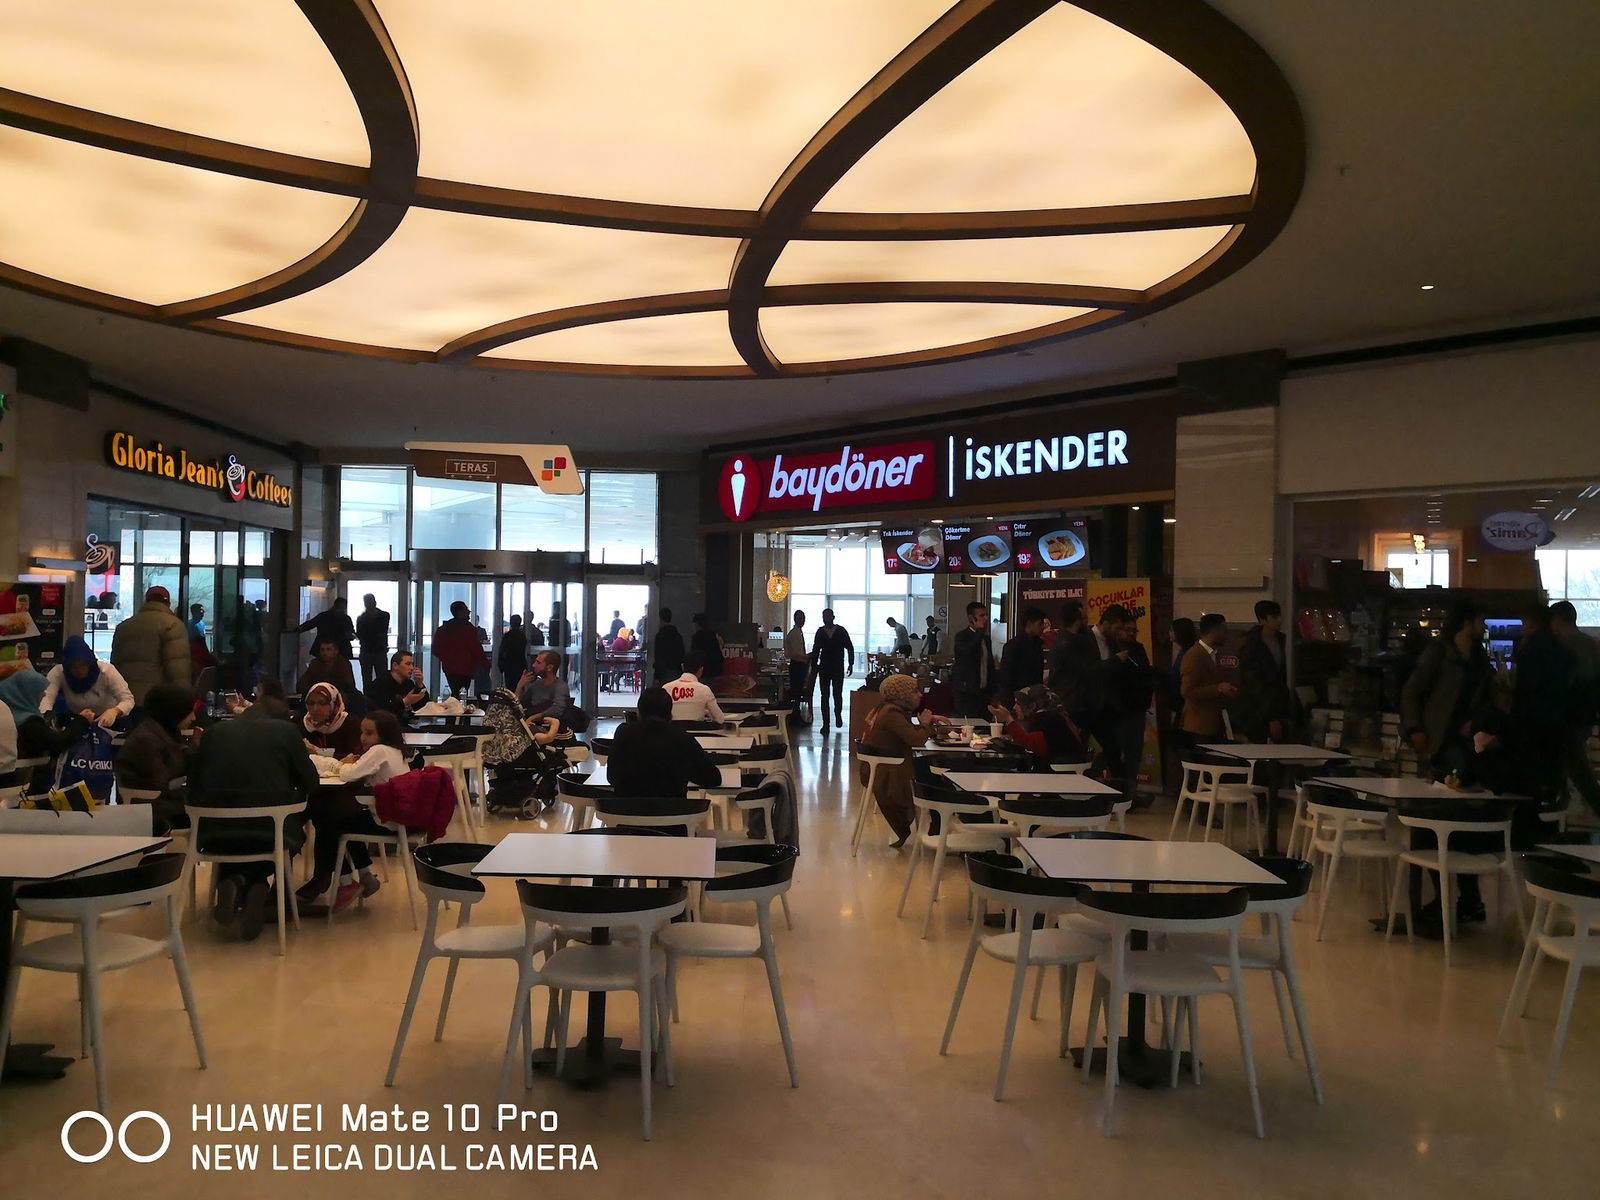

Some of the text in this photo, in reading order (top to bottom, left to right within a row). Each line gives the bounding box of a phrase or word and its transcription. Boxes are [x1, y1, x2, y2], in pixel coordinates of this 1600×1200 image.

[112, 432, 292, 505] Gloria Jean's Coffees
[453, 461, 488, 474] TERAS
[768, 429, 1129, 512] baydöner İSKENDER
[70, 758, 87, 769] LC
